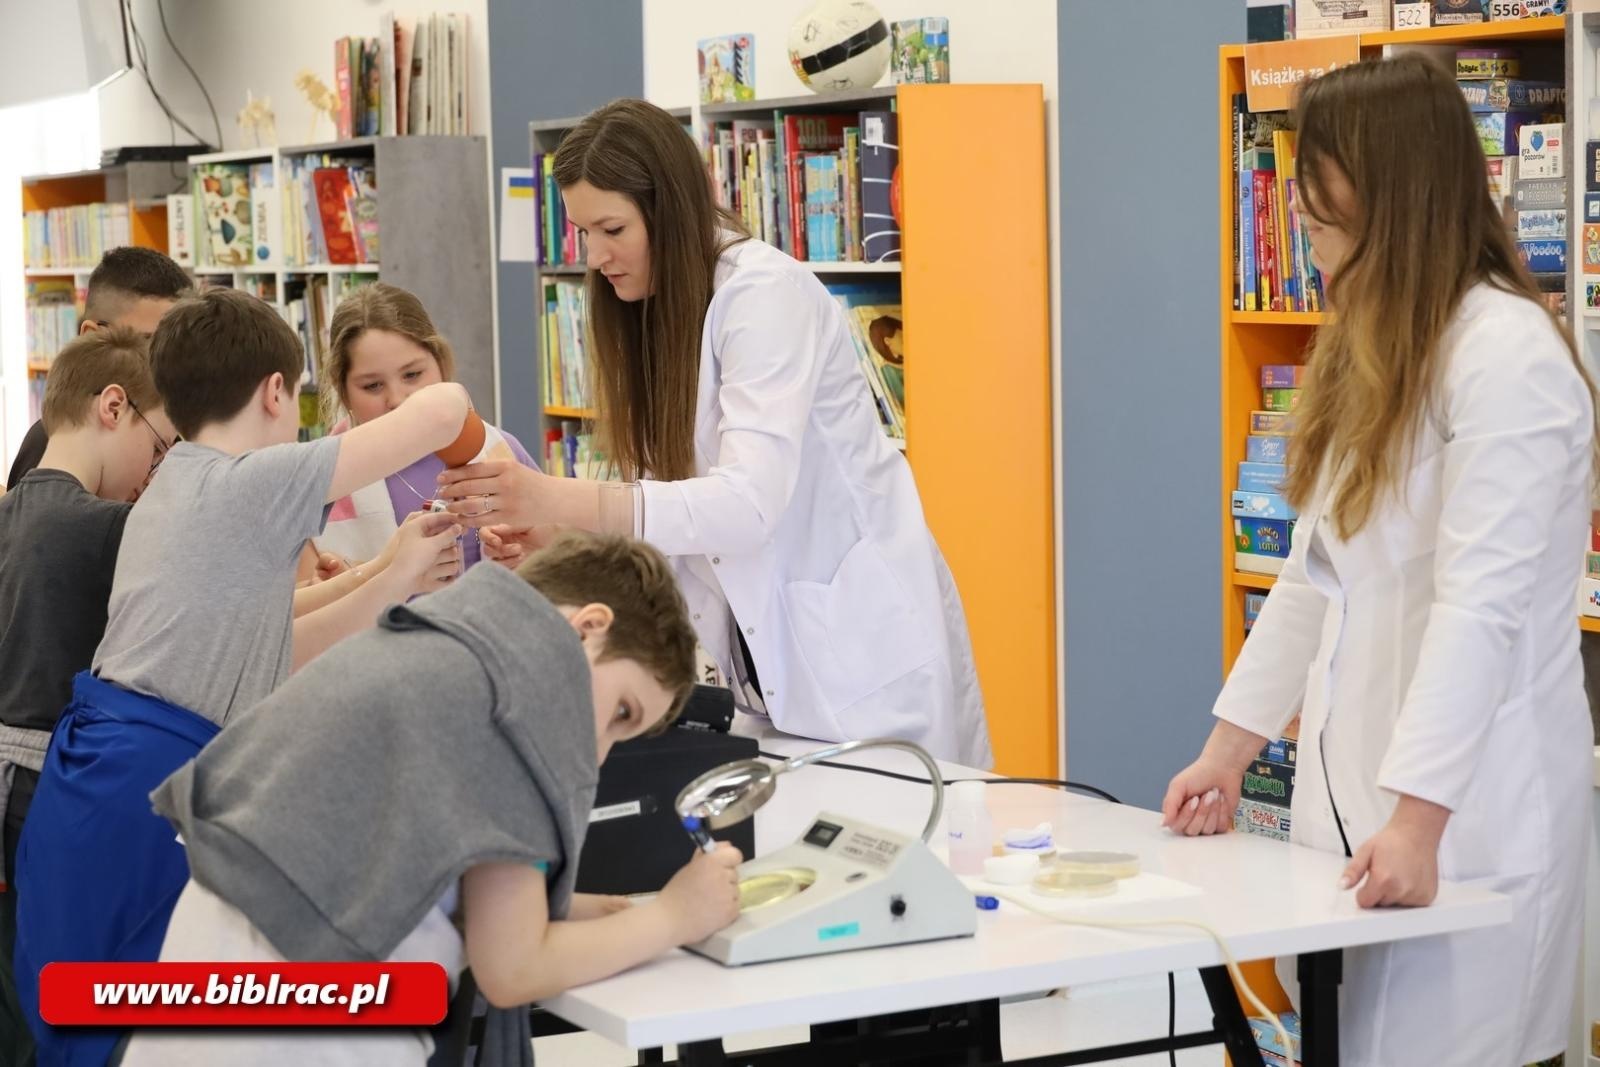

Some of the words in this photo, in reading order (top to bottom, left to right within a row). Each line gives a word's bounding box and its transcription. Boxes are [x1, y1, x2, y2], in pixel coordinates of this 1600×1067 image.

[1398, 9, 1422, 27] 522
[1494, 4, 1520, 17] 556
[1250, 66, 1305, 89] Książka
[1523, 243, 1562, 261] Voodoo
[1257, 526, 1279, 539] BINGO
[1258, 542, 1280, 552] LOTTO
